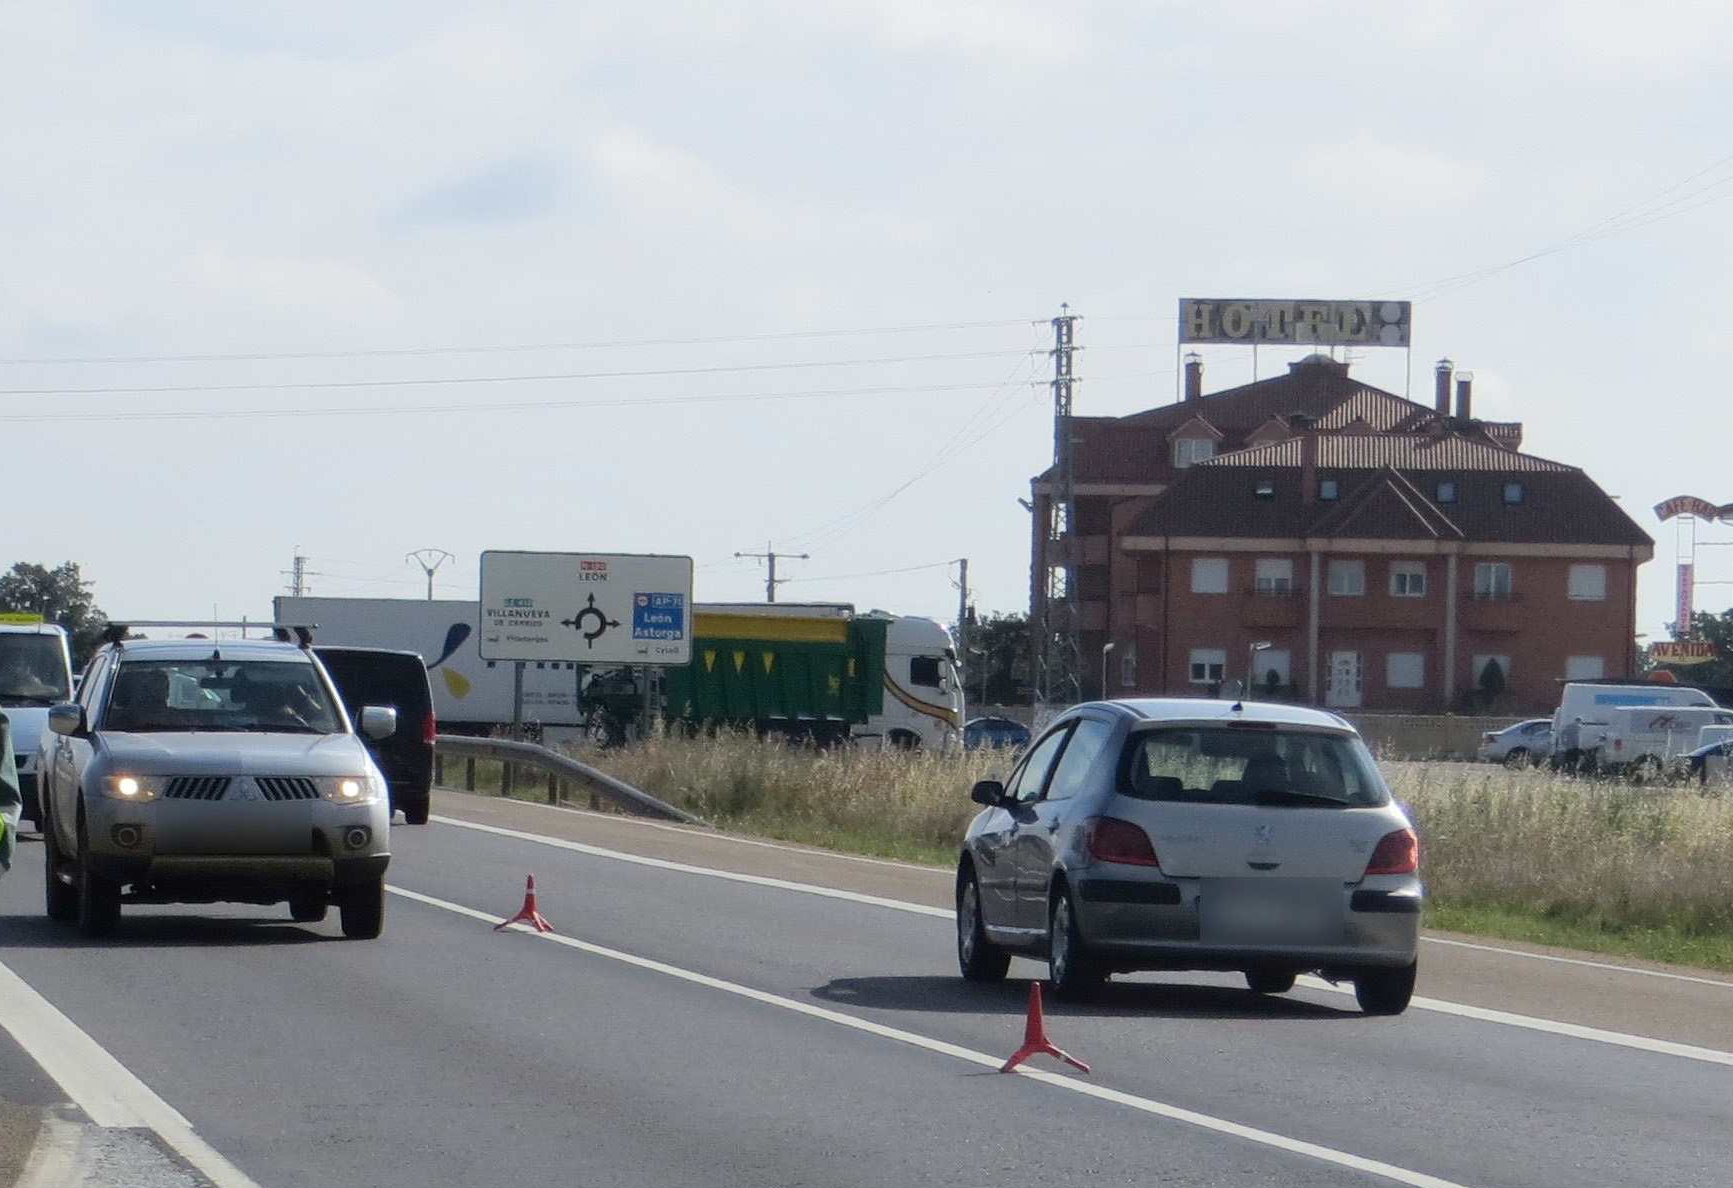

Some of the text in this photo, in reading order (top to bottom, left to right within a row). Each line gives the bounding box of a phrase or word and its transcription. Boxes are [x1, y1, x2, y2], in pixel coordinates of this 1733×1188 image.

[1186, 300, 1370, 342] HOTEL
[487, 609, 551, 619] VILLANUEVA
[643, 612, 673, 624] León
[494, 619, 544, 628] DE CARRIZO
[634, 627, 683, 640] Astorga
[1651, 643, 1717, 658] AVENIDA
